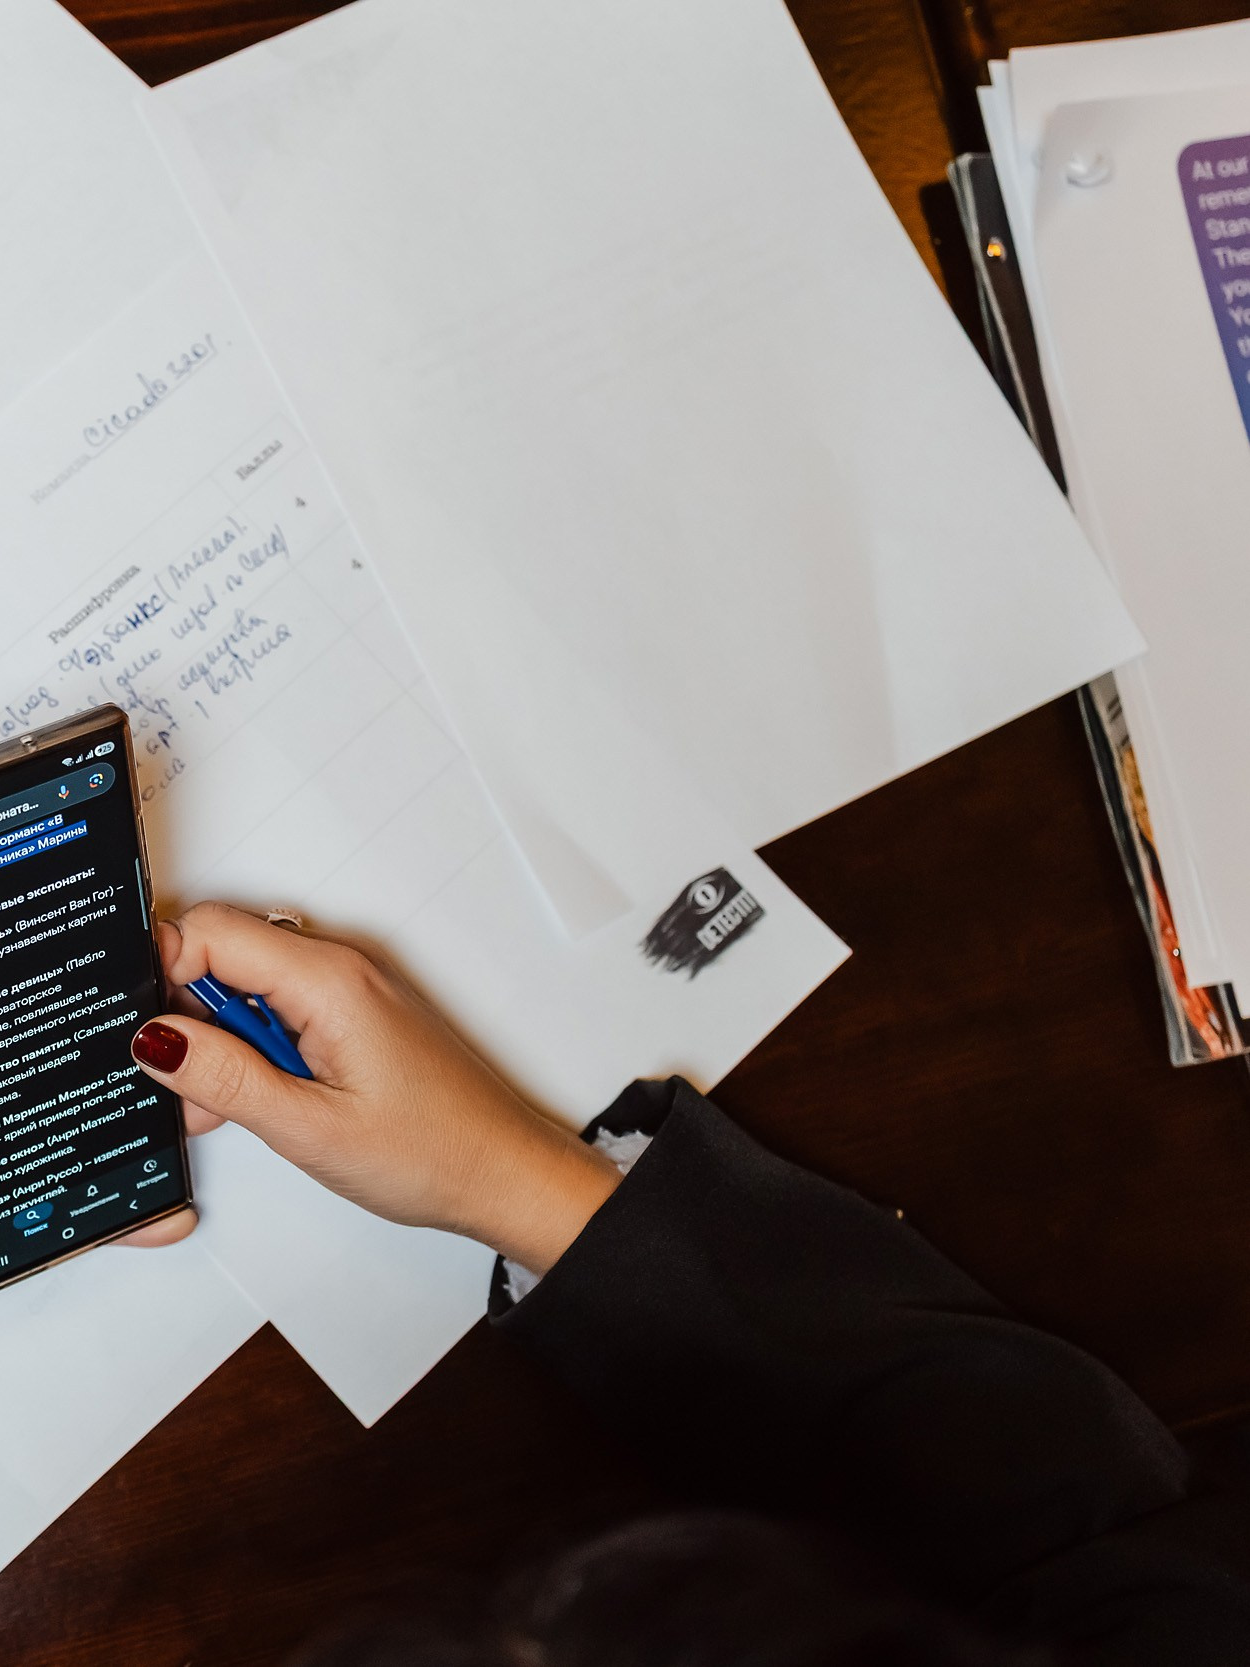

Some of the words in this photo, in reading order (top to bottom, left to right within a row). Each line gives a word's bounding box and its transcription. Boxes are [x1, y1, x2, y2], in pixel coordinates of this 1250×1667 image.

[47, 565, 141, 644] Расшифровка
[37, 824, 87, 850] Марины
[47, 813, 63, 827] «В
[26, 867, 95, 900] экспонаты:
[14, 905, 67, 933] (Винсент
[68, 896, 91, 911] Ван
[92, 885, 114, 902] Гог)
[67, 907, 107, 929] картин
[109, 904, 117, 913] в
[10, 967, 64, 995] девицы»
[65, 950, 106, 972] (Пабло
[13, 992, 83, 1026] повлиявшее
[84, 986, 98, 997] на
[67, 992, 127, 1021] искусства.
[21, 1037, 71, 1063] памяти»
[73, 1010, 138, 1043] (Сальвадор
[37, 1049, 81, 1073] шедевр
[2, 1098, 57, 1126] Мэрилин
[58, 1079, 105, 1103] Монро»
[106, 1061, 140, 1084] (Энди
[3, 1120, 37, 1142] яркий
[38, 1104, 81, 1127] пример
[82, 1083, 135, 1109] поп-арта.
[9, 1142, 45, 1161] окно»
[46, 1127, 80, 1147] (Анри
[80, 1106, 125, 1132] Матисс)
[136, 1095, 158, 1109] вид
[12, 1179, 45, 1199] (Анри
[46, 1161, 83, 1184] Руссо)
[93, 1135, 148, 1164] известная
[13, 1145, 76, 1176] художника.
[23, 1223, 48, 1237] Поиск
